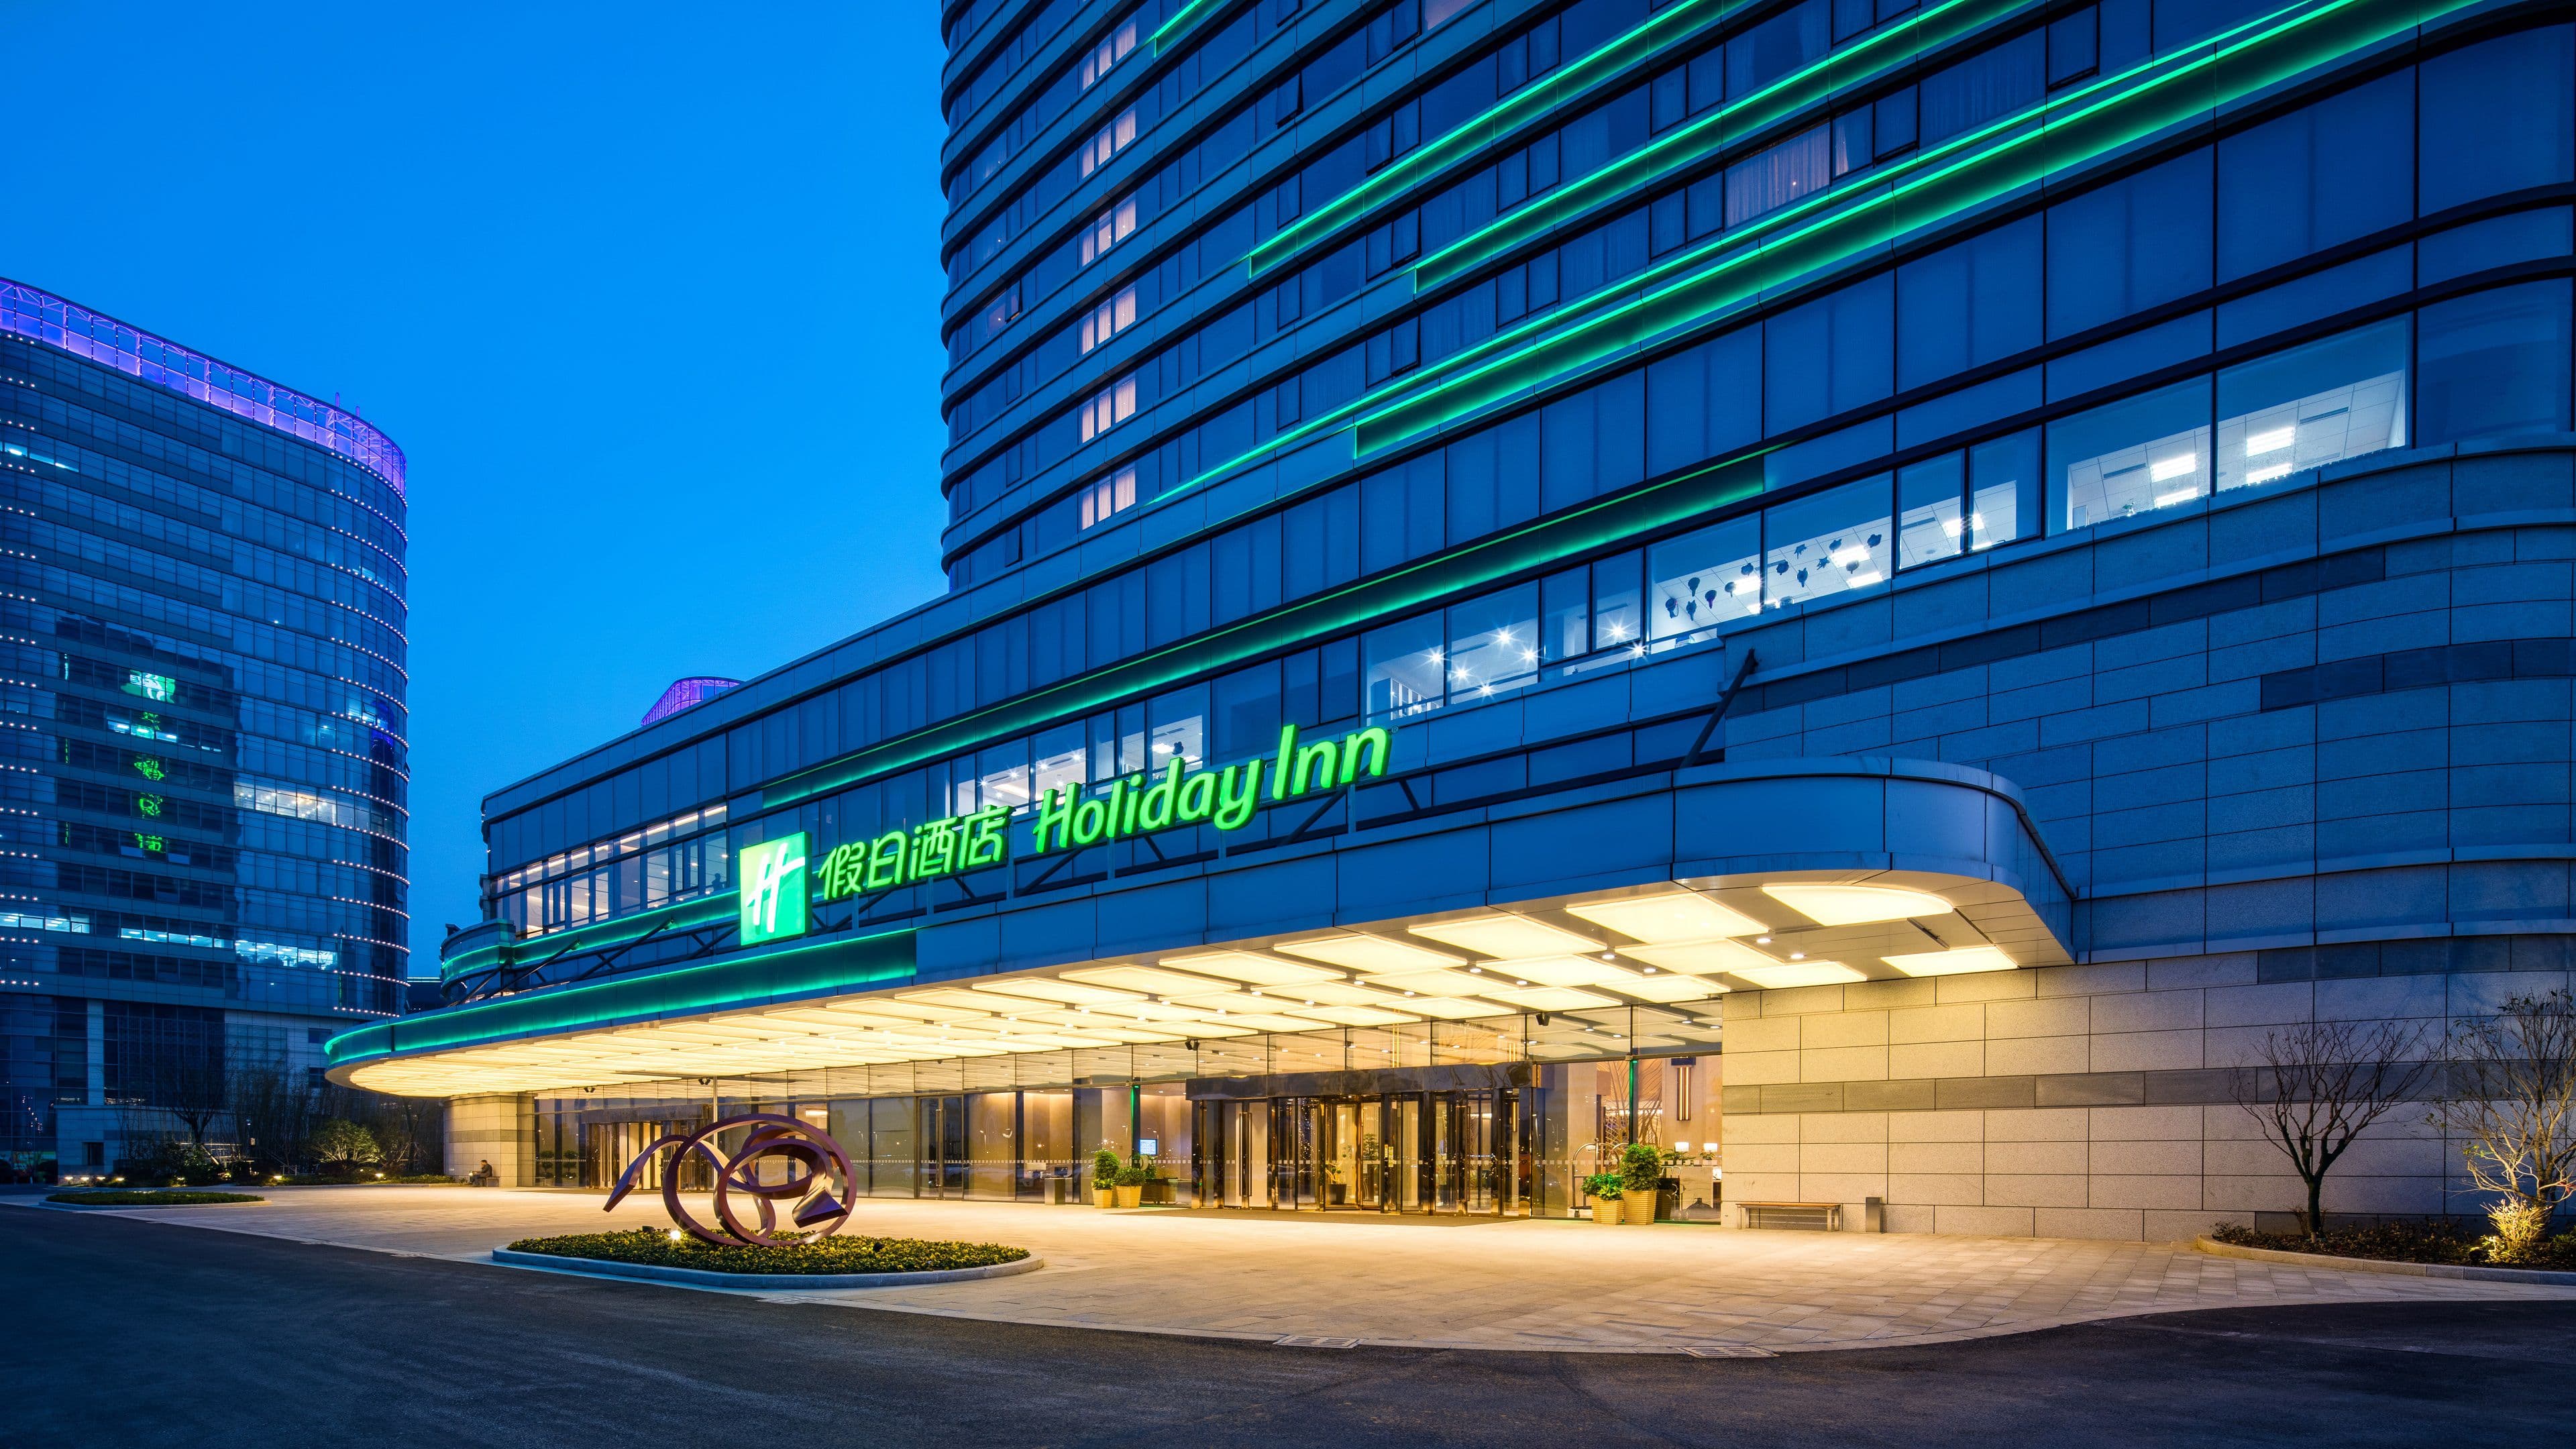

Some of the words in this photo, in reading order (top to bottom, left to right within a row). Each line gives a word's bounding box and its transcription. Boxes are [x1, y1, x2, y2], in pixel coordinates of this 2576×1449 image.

[1032, 757, 1263, 854] Holiday
[1272, 723, 1391, 800] Inn
[818, 804, 1012, 901] 假日酒店
